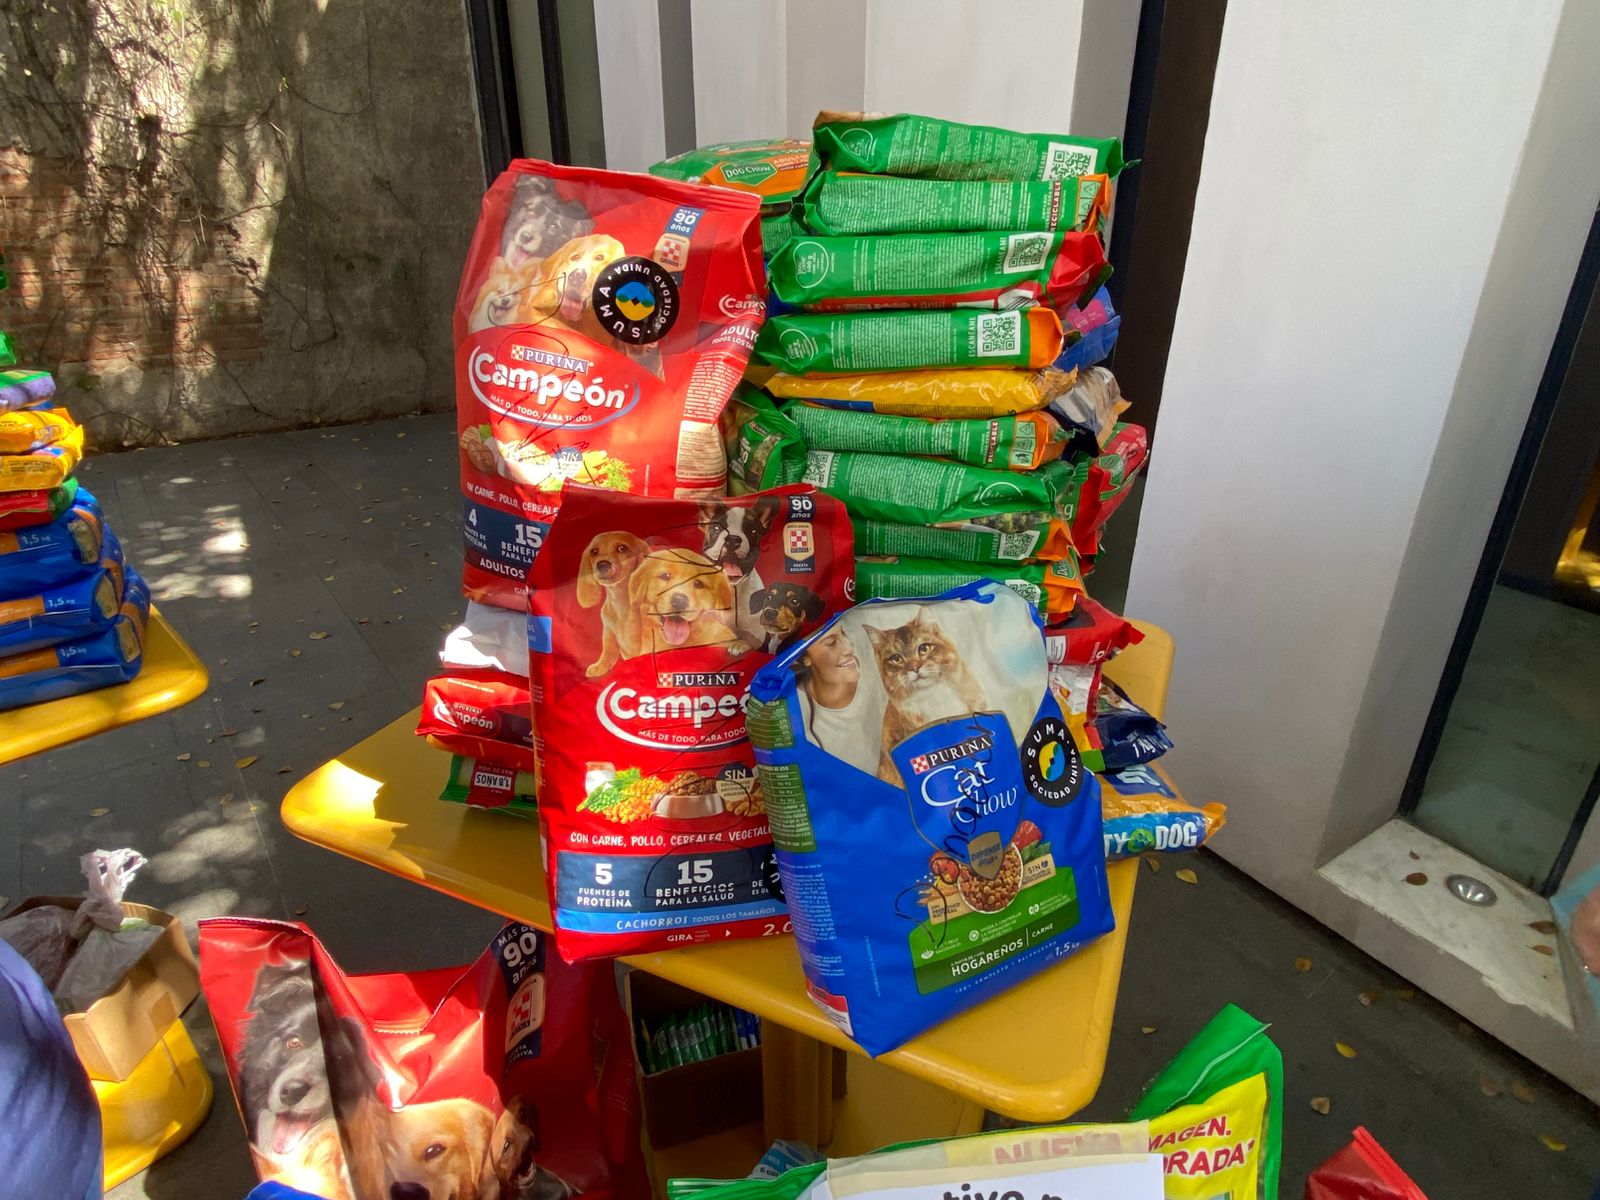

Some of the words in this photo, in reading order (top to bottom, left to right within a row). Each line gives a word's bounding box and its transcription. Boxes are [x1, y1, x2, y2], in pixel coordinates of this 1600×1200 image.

[674, 212, 697, 225] 90
[614, 264, 650, 275] UNIDA
[654, 275, 672, 330] SOCIEDAD
[599, 286, 640, 338] SUMA
[526, 350, 586, 373] PURINA
[474, 352, 626, 409] Campeón
[522, 502, 558, 516] CEREALE
[791, 499, 812, 511] 90
[469, 508, 478, 526] 4
[515, 523, 543, 548] 15
[501, 541, 540, 558] BENEFIC
[480, 558, 525, 580] ADULTOS
[48, 598, 64, 608] 1,5
[60, 646, 76, 657] 1,5
[675, 674, 736, 686] PURINA
[610, 684, 750, 728] Campeó
[658, 733, 669, 742] DE
[723, 726, 746, 739] TODO
[1027, 723, 1065, 756] SUMA
[929, 736, 991, 766] PURINA
[724, 768, 746, 780] SIN
[1069, 748, 1078, 784] UNIDA
[921, 761, 995, 807] Cat
[1029, 774, 1071, 800] SOCIEDAD
[570, 832, 589, 844] CON
[591, 835, 627, 848] CARNE,
[728, 825, 772, 841] VEGETAL
[1155, 822, 1198, 850] DOG
[595, 863, 612, 885] 5
[677, 859, 714, 885] 15
[1028, 864, 1040, 874] SIN
[578, 887, 615, 896] FUENTES
[656, 882, 735, 898] BENEFICIOS
[656, 898, 684, 906] PARA
[686, 896, 698, 904] LA
[702, 892, 735, 902] SALUD
[577, 895, 632, 908] PROTEÍNA
[692, 915, 720, 923] TODOS
[722, 912, 736, 920] LOS
[737, 906, 776, 918] TAMAÑOS
[666, 933, 692, 942] GIRA
[1032, 923, 1054, 938] CARNE
[503, 932, 537, 968] 90
[952, 938, 1023, 976] HOGAREÑOS
[1055, 941, 1070, 958] 1,5
[1149, 1115, 1232, 1152] MAGEN.
